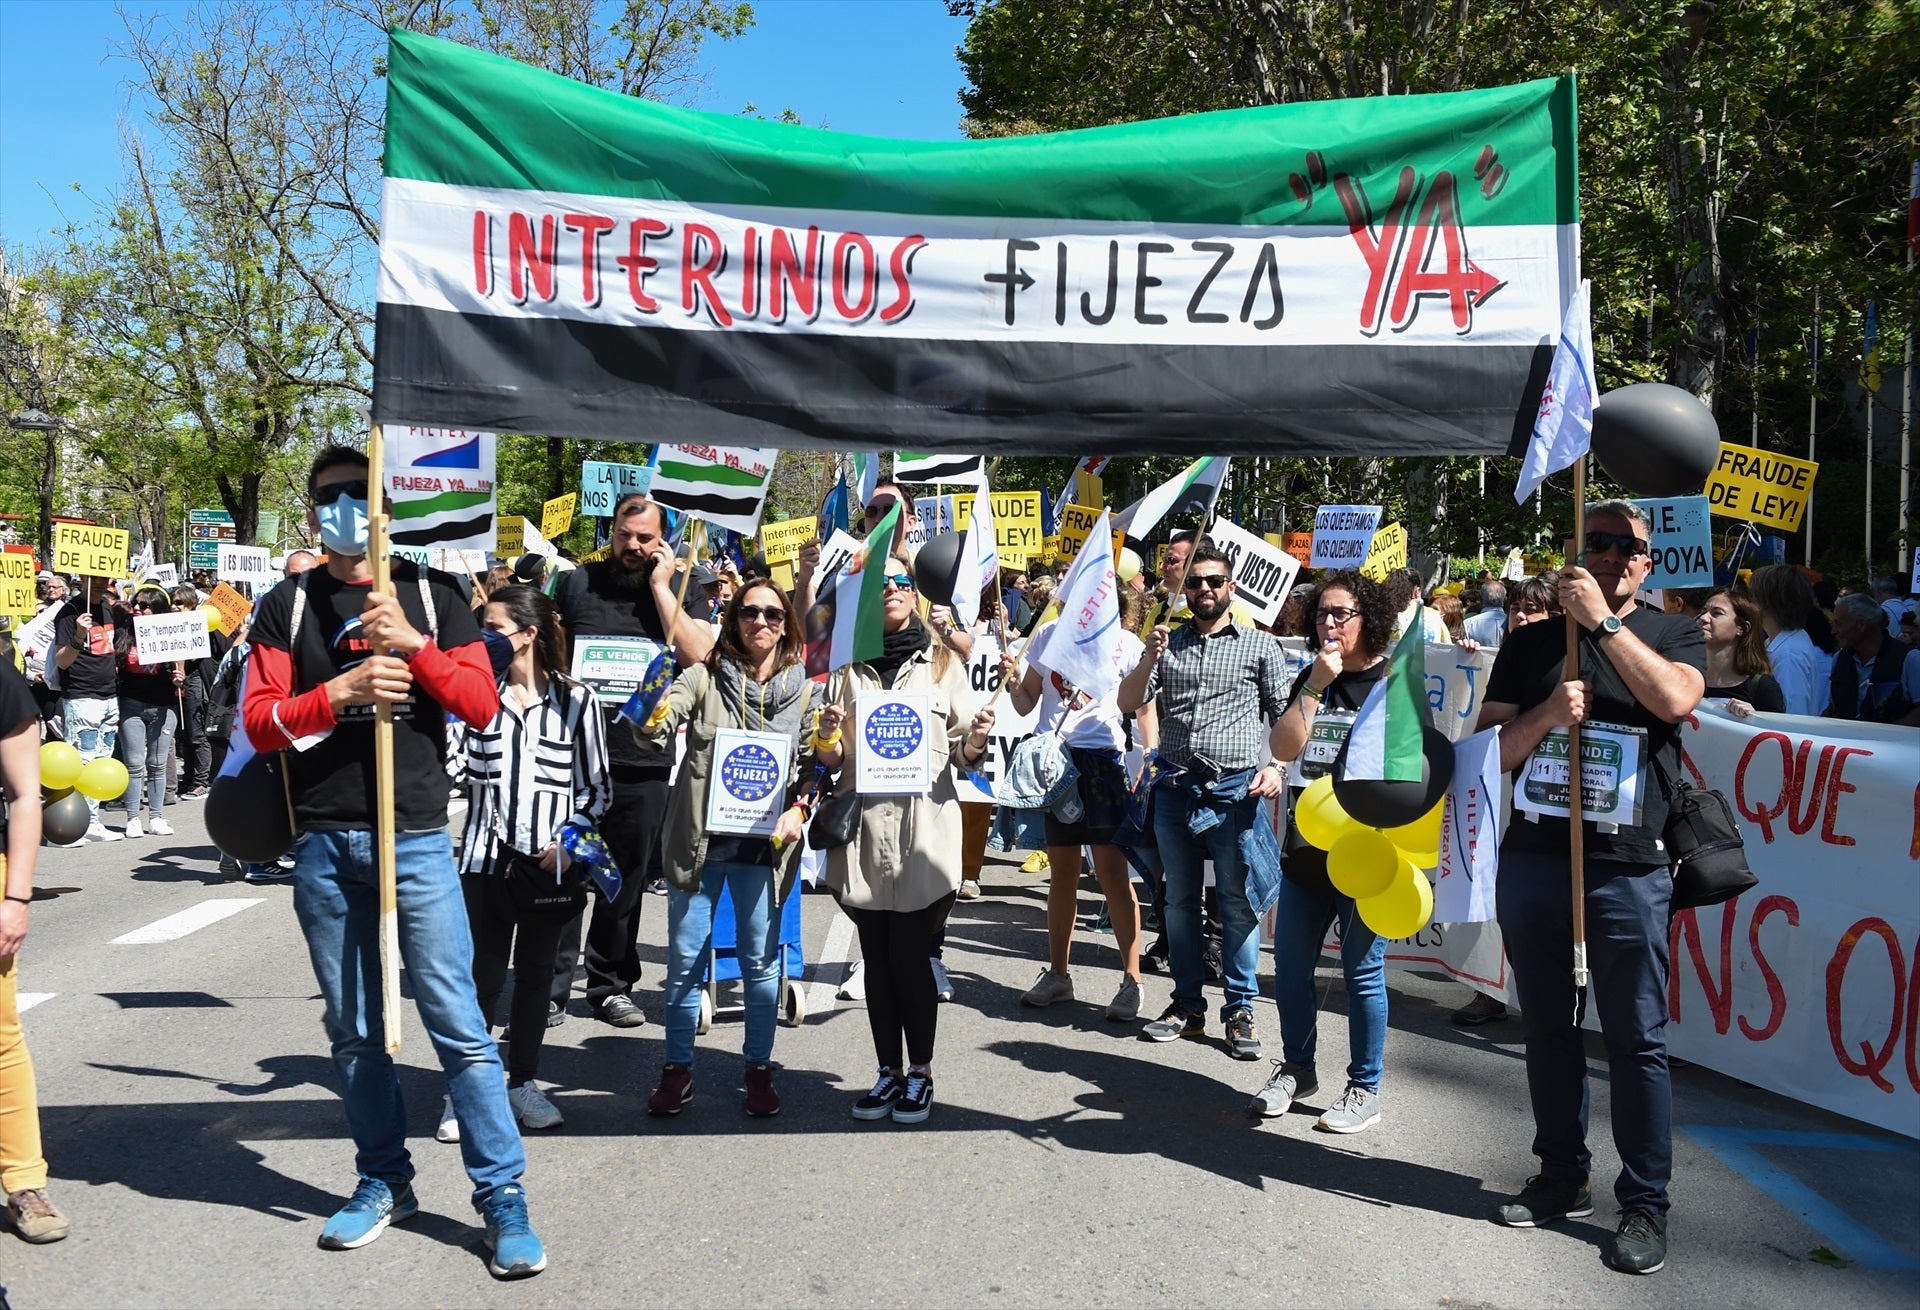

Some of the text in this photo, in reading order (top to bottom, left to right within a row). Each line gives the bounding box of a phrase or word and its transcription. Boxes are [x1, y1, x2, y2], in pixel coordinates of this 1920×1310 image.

[472, 211, 928, 327] INTERINOS
[984, 240, 1284, 330] FIJEZA
[598, 468, 639, 486] LA U.E.
[1717, 450, 1810, 491] FRAUDE
[392, 476, 443, 491] FIJEZA
[584, 491, 608, 508] NOS
[1710, 482, 1799, 523] DE LEY!
[1316, 512, 1330, 529] LOS
[1330, 513, 1345, 530] QUE
[61, 529, 123, 550] FRAUDE
[996, 528, 1036, 546] LEY!
[1316, 540, 1329, 557] NOS
[60, 551, 122, 572] DE LEY!
[8, 589, 31, 608] LEY!
[139, 622, 202, 637] Ser "temporal" por
[160, 641, 168, 652] 20
[589, 651, 646, 662] SE VENDE
[877, 727, 912, 739] FIJEZA
[1314, 727, 1328, 737] SE
[1312, 747, 1325, 756] 15
[1540, 741, 1613, 760] SE VNDE
[733, 767, 768, 782] FIJEZA
[1538, 763, 1549, 775] 11
[1589, 790, 1600, 798] DE
[1735, 731, 1874, 847] QUE
